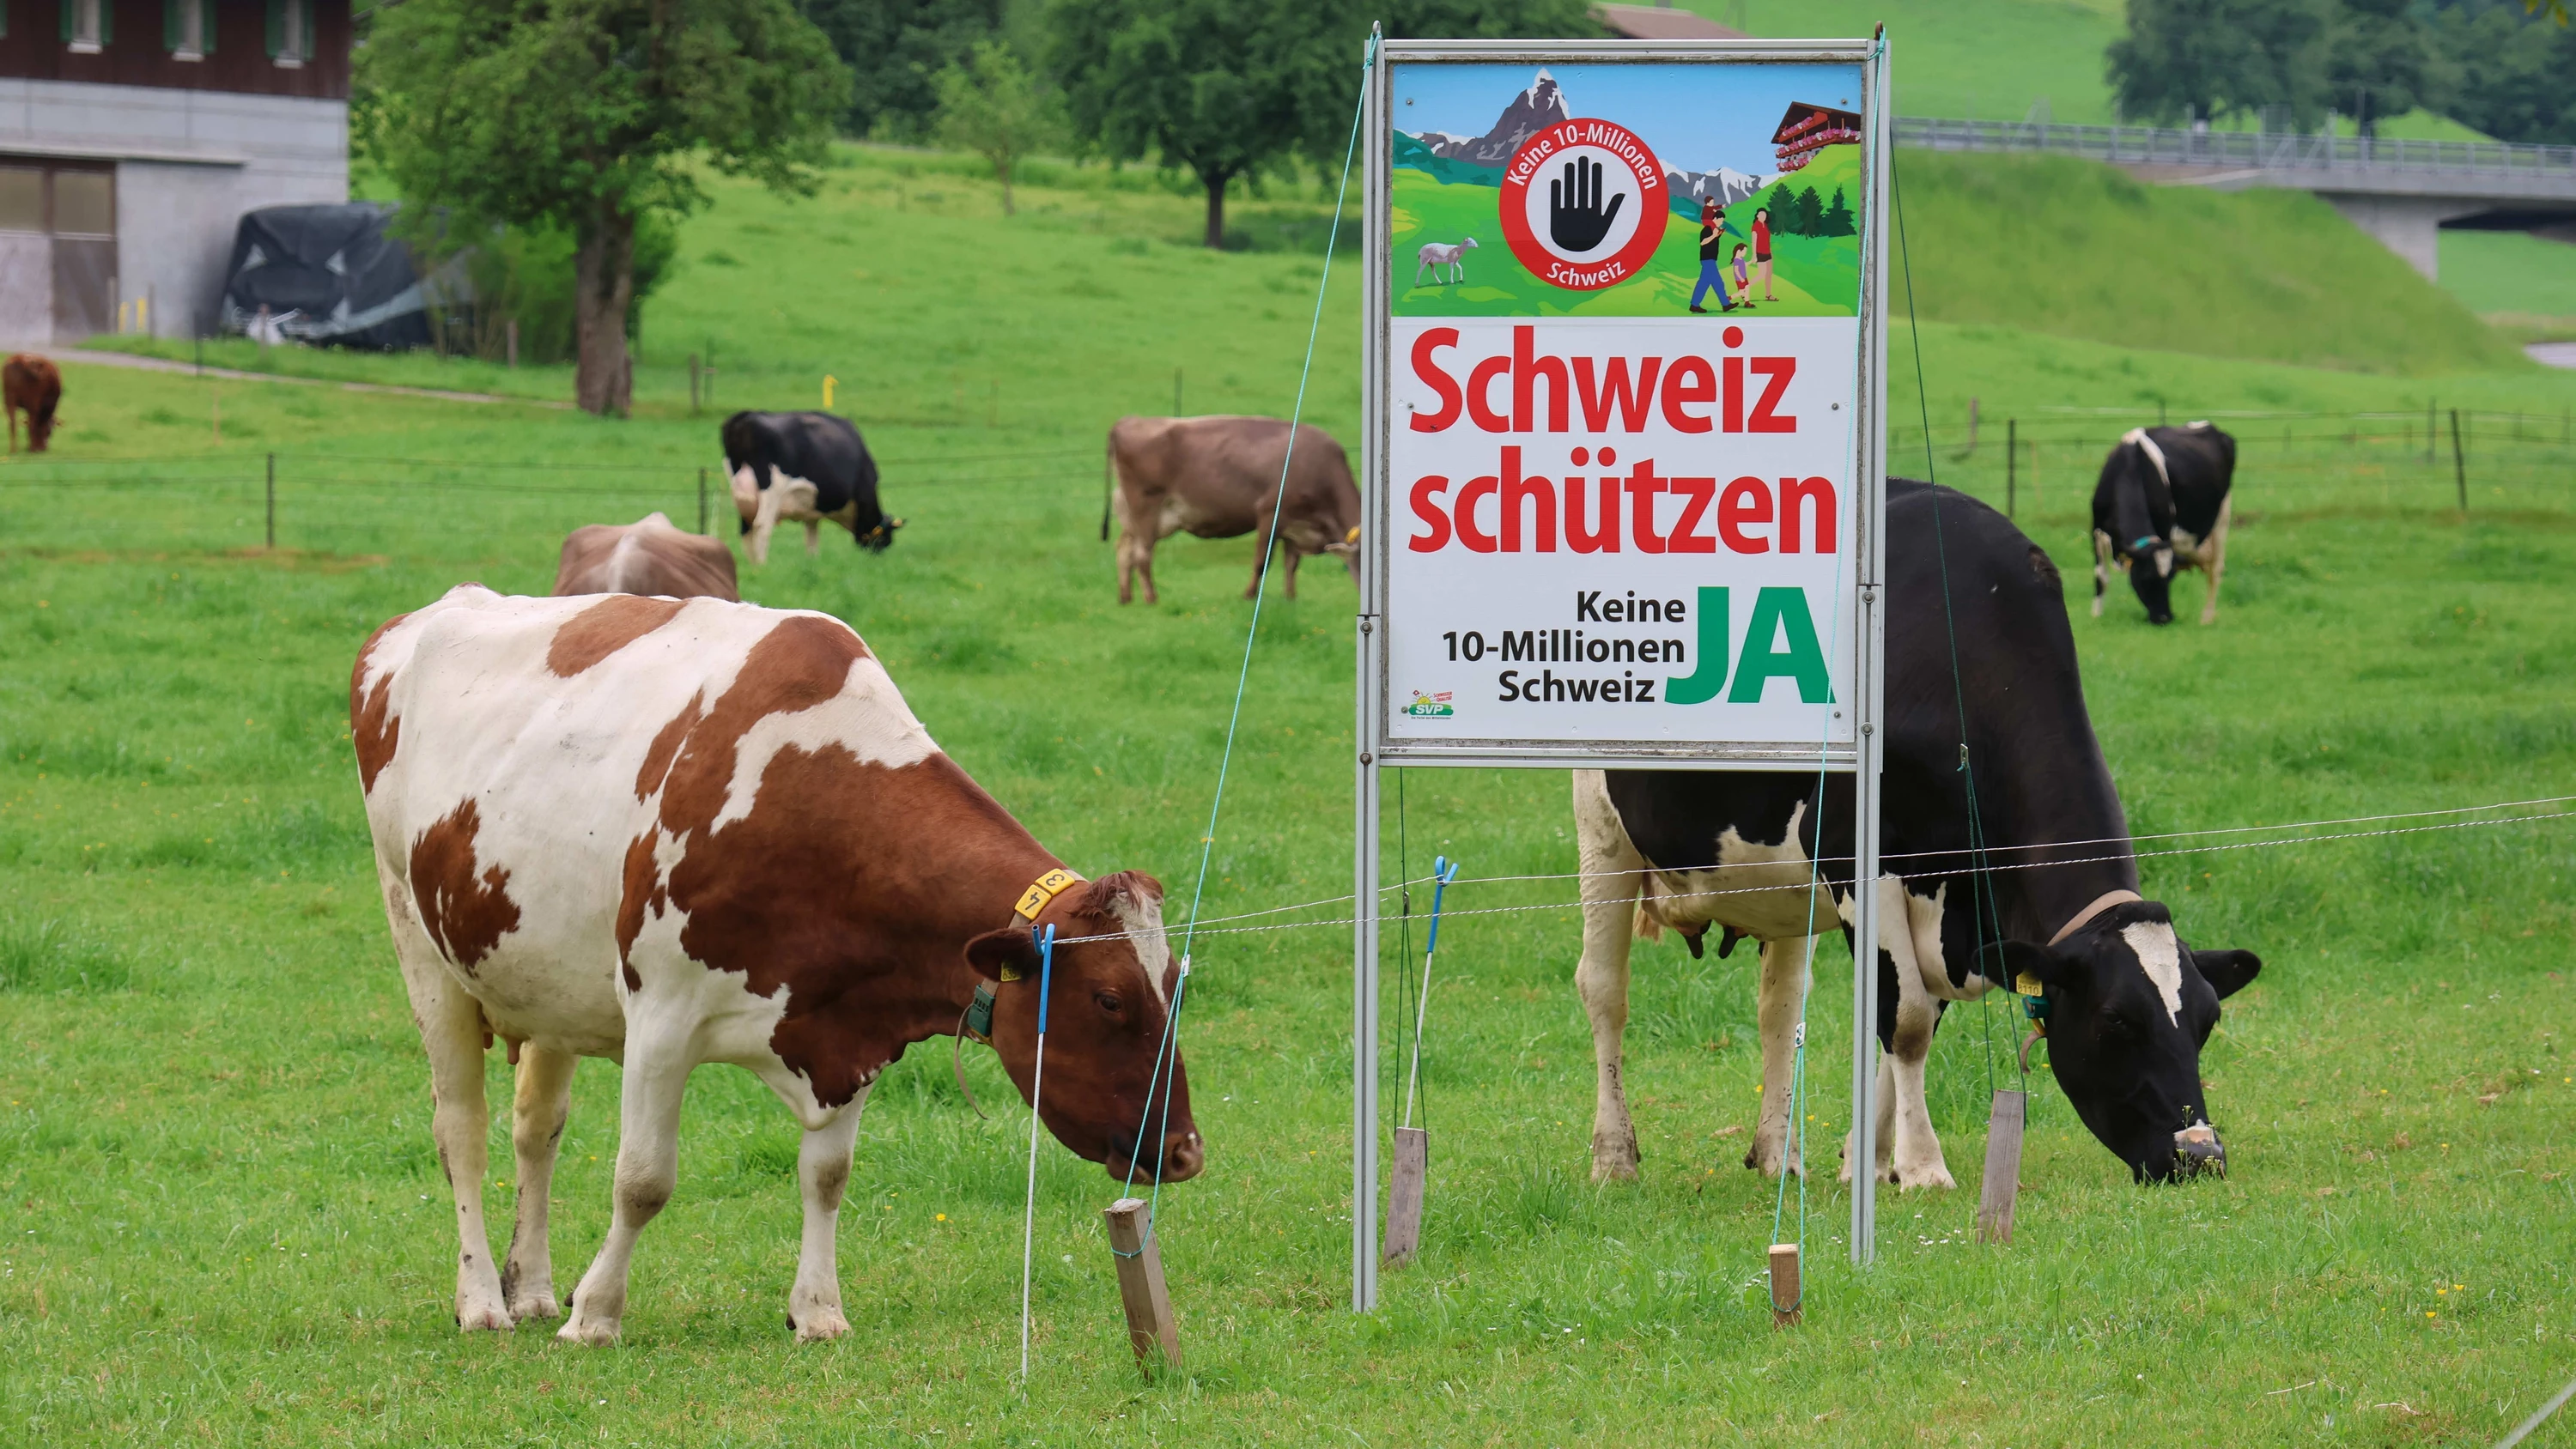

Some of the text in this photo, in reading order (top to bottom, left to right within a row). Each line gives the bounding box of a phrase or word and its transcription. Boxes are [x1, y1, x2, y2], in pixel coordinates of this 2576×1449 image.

[1507, 123, 1658, 190] Keine 10-Millionen
[1546, 261, 1626, 287] Schweiz
[1409, 325, 1797, 433] Schweiz
[1409, 446, 1837, 555] schützen
[1577, 591, 1686, 622] Keine
[1443, 630, 1685, 663] 10-Millionen
[1664, 586, 1836, 705] JA
[1498, 670, 1655, 702] Schweiz
[1415, 704, 1444, 714] SVP
